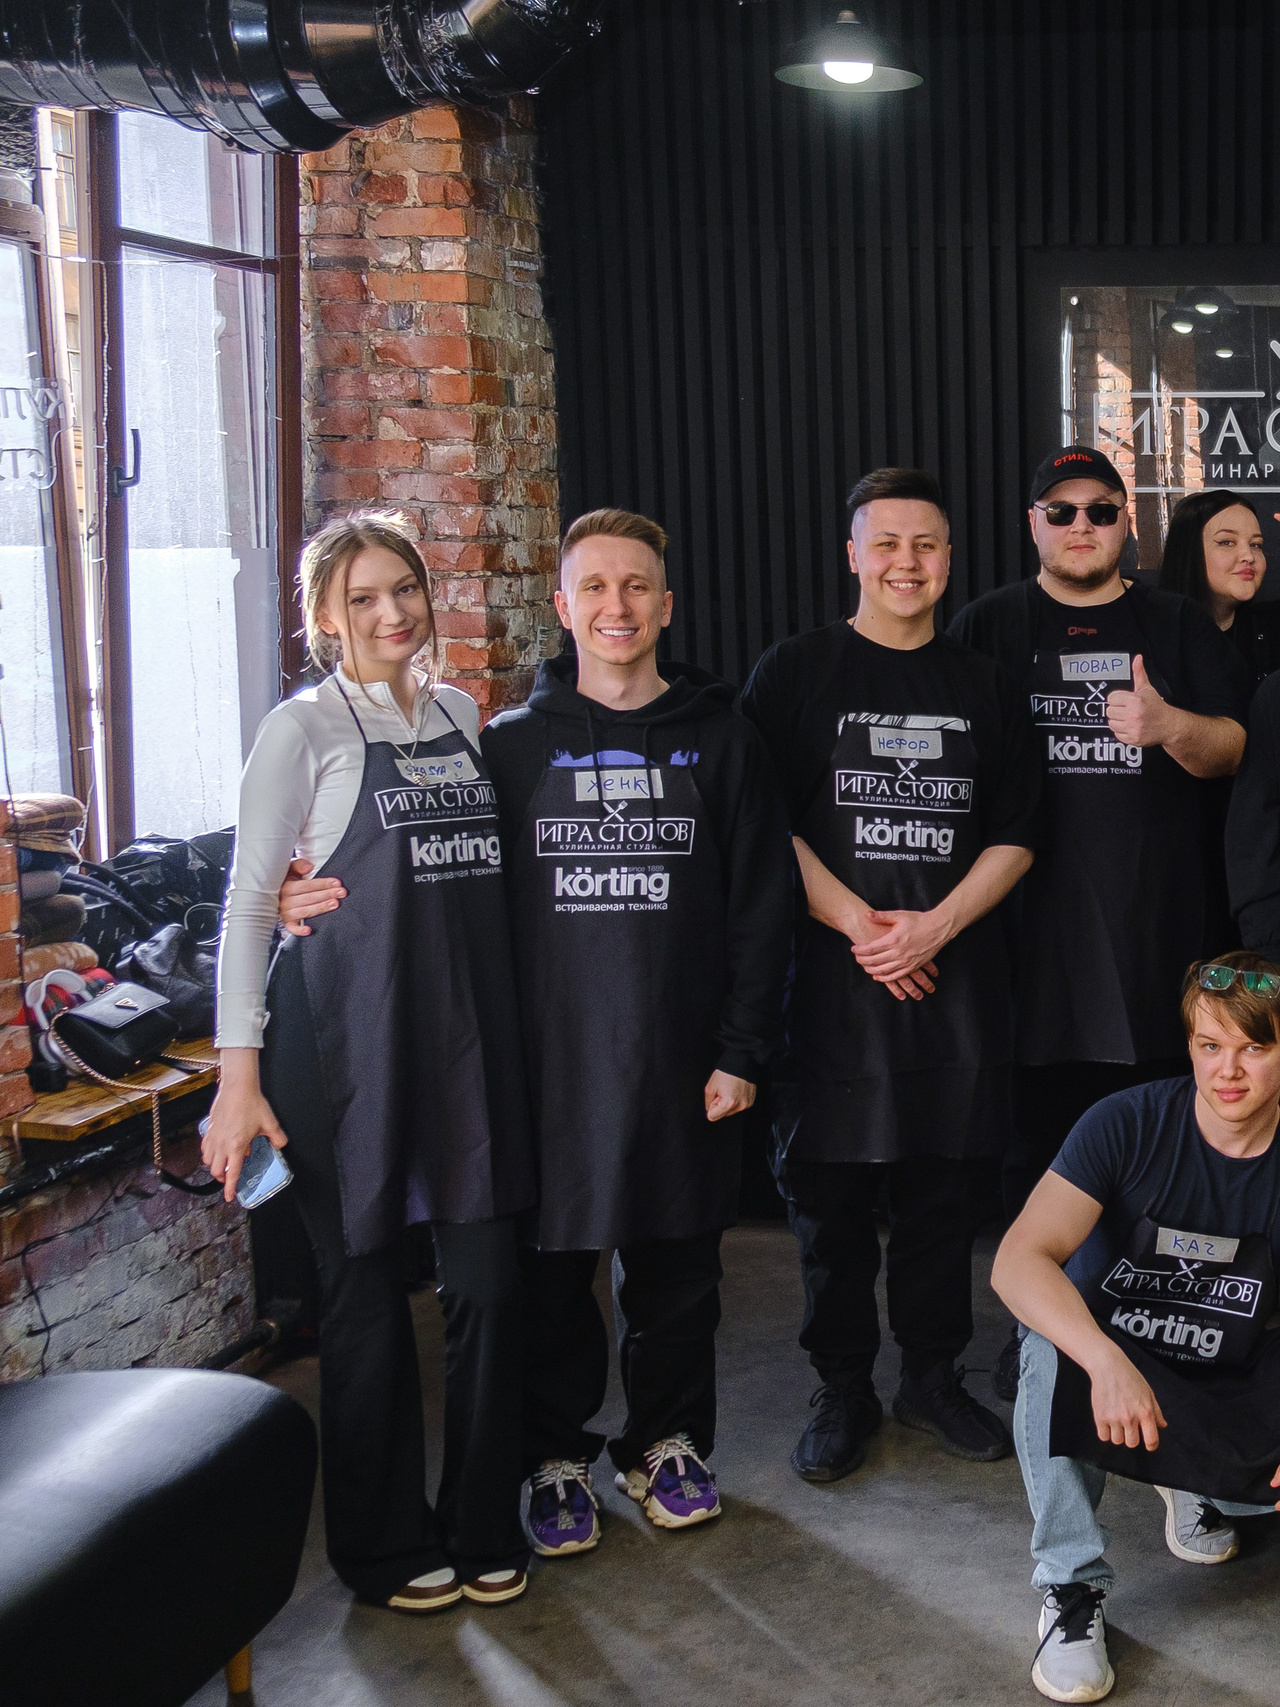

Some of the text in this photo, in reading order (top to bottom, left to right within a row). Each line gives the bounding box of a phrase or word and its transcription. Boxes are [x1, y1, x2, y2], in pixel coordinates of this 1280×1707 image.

[1108, 406, 1253, 456] ИГРА
[1054, 453, 1093, 467] СТИЛЬ
[1069, 658, 1123, 673] ПОВАР
[1035, 698, 1080, 716] ИГРА
[1048, 735, 1143, 768] körting
[1049, 767, 1142, 775] встраиваемая техника
[382, 785, 498, 813] ИГРА СТОЛО
[840, 774, 970, 800] ИГРА СТОЛОВ
[859, 795, 916, 805] КУЛИНАРНАЯ
[541, 823, 593, 843] ИГРА
[855, 816, 955, 855] körting
[410, 832, 502, 867] körting
[855, 850, 920, 862] встраиваемая
[555, 867, 670, 902] körting
[555, 902, 668, 913] встраиваемая техника
[1113, 1264, 1254, 1303] ИГРА СТОЛОВ
[1110, 1306, 1224, 1358] körting
